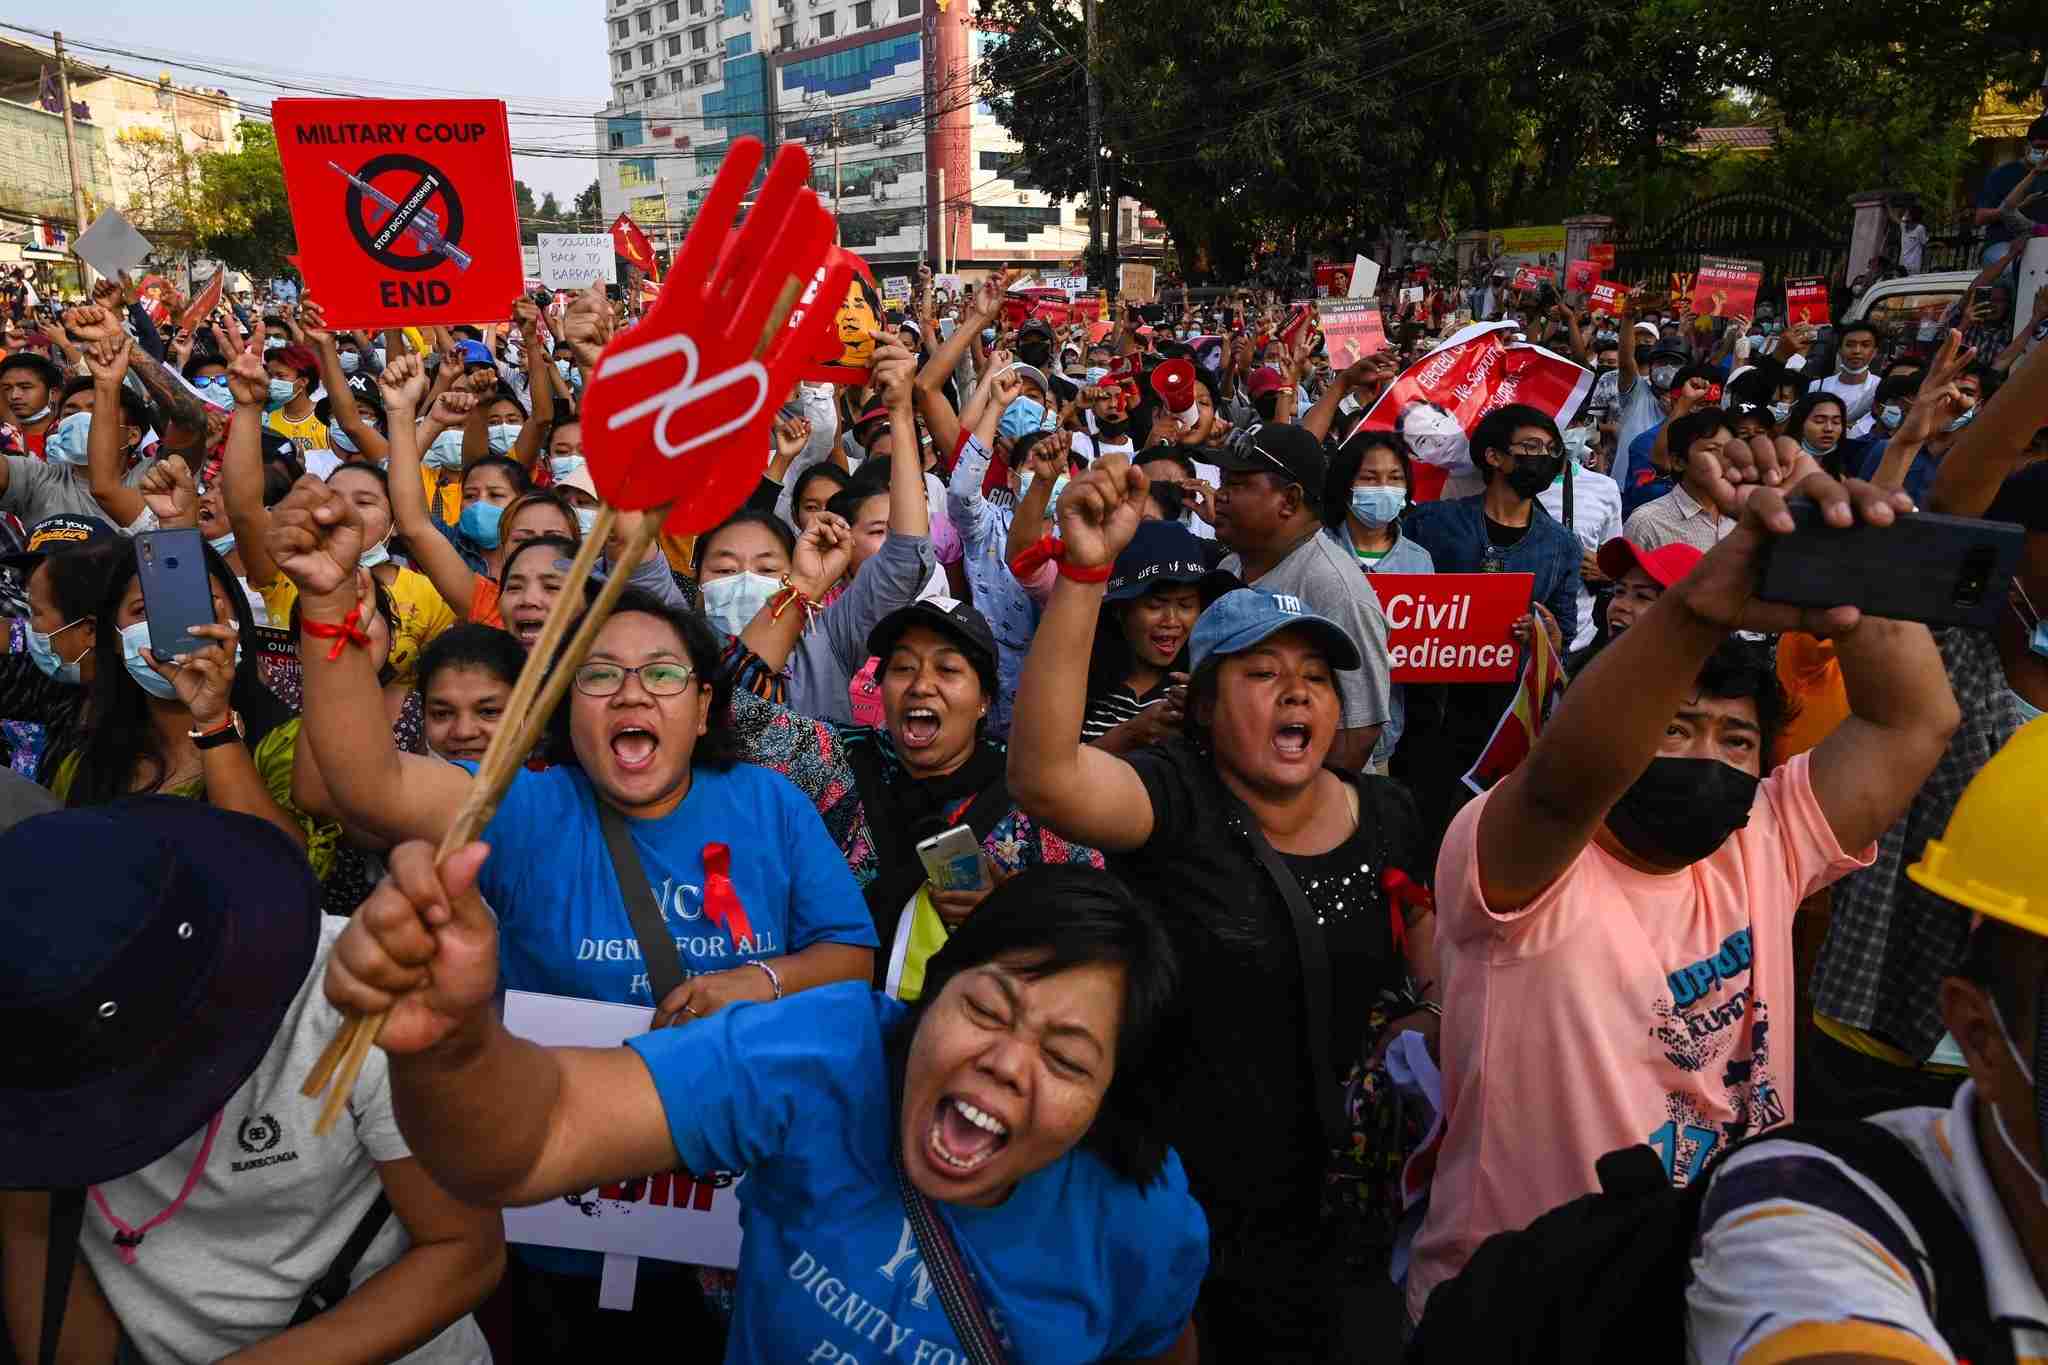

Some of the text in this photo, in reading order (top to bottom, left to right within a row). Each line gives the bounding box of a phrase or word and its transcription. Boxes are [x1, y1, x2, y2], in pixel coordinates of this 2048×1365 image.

[296, 123, 485, 144] MILITARY COUP
[374, 181, 432, 250] STOP DICTATORSHIP
[380, 281, 451, 307] END
[1053, 278, 1081, 289] FREE
[1453, 382, 1473, 402] We
[1386, 593, 1472, 630] Civil
[267, 641, 294, 654] OUR
[1390, 637, 1514, 669] edience
[577, 930, 777, 961] DIGN FOR ALL
[787, 1250, 914, 1357] DIGNITY
